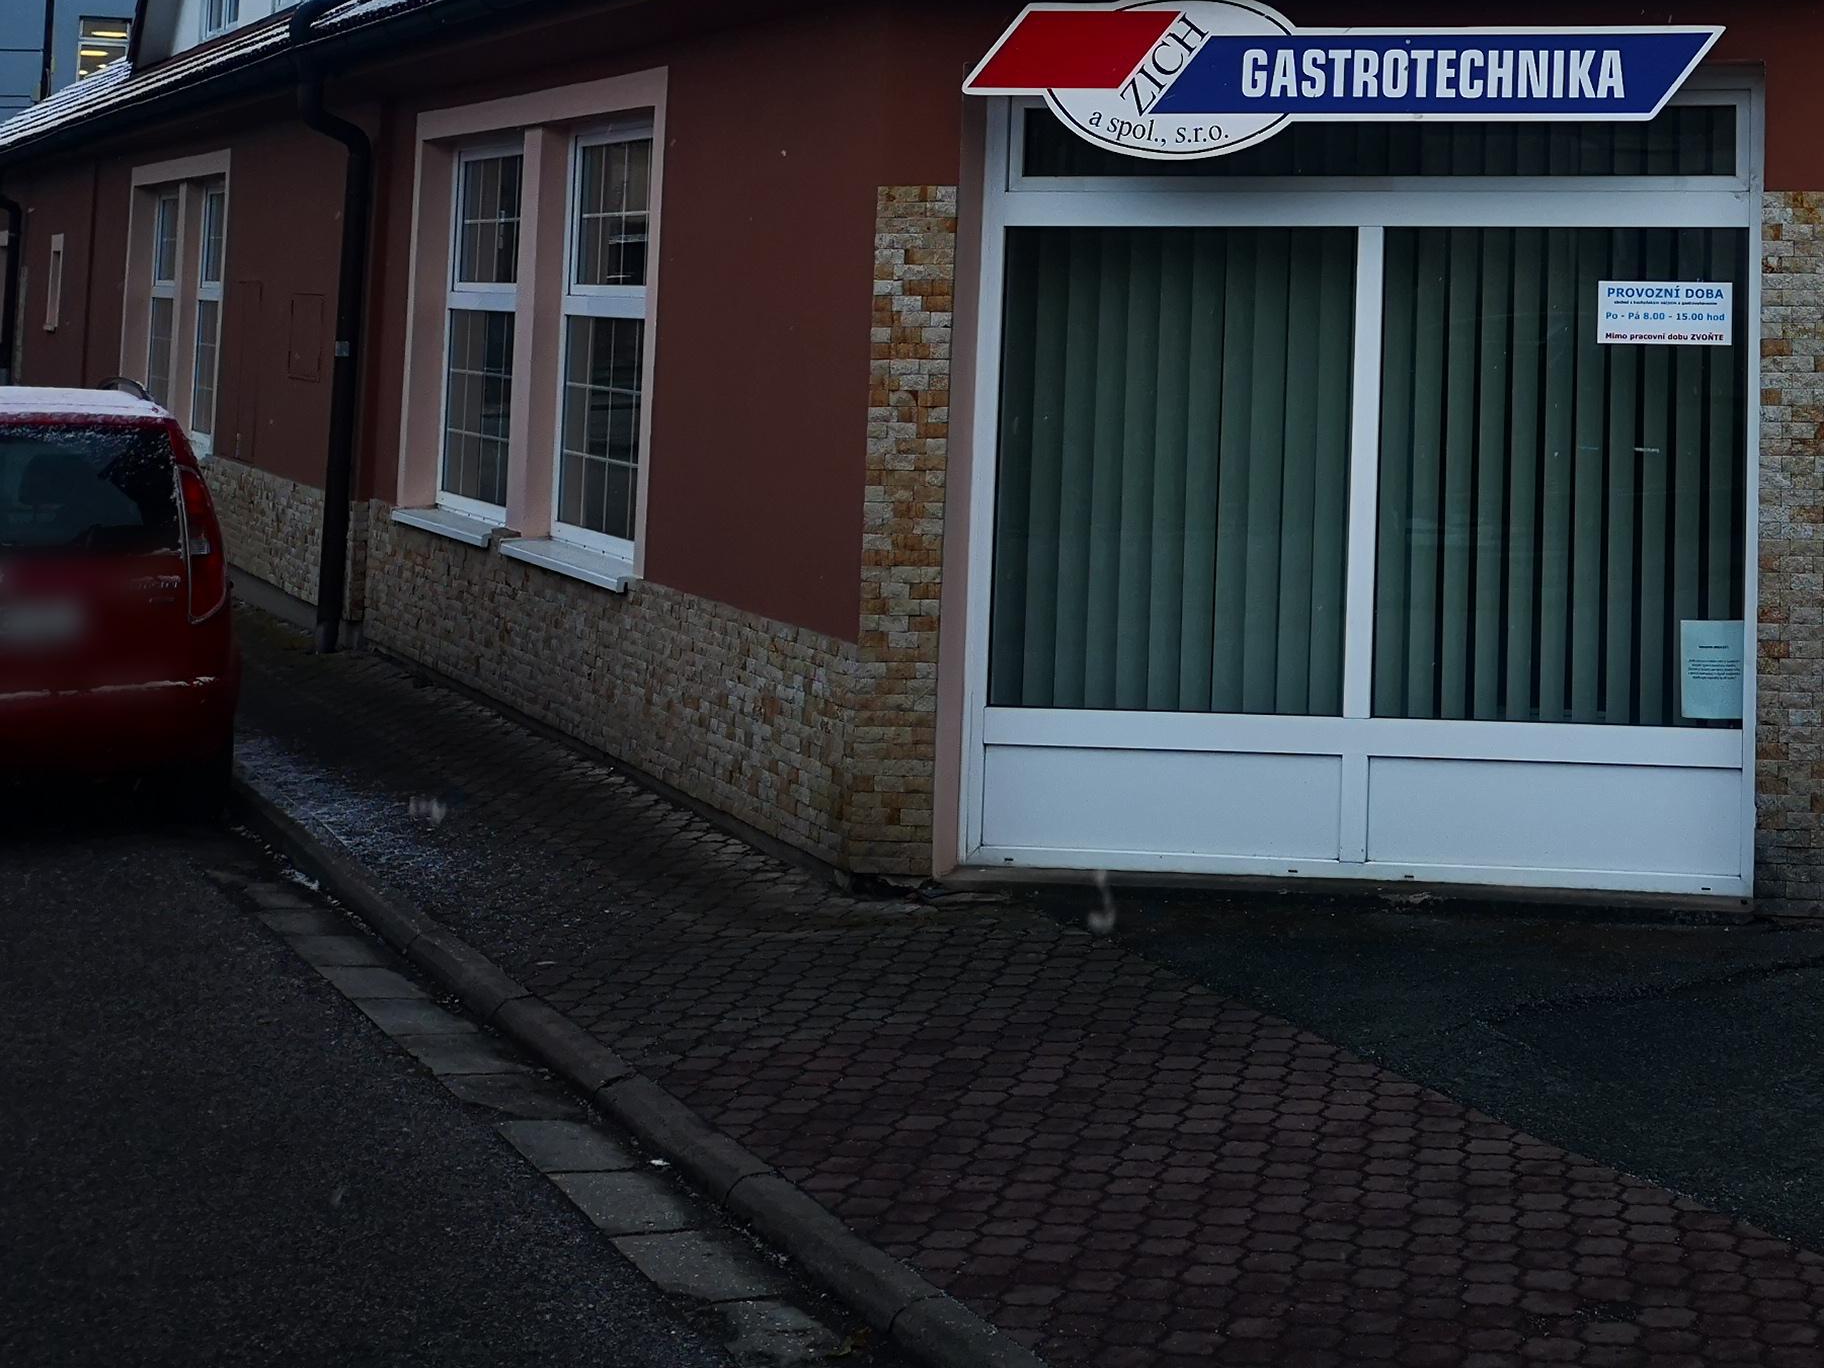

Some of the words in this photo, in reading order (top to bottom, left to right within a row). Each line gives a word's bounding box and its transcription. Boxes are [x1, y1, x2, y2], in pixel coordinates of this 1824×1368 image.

[1119, 11, 1210, 118] ZICH
[1240, 48, 1626, 99] GASTROTECHNIKA
[1088, 110, 1103, 128] a
[1106, 119, 1167, 148] spol.,
[1175, 124, 1230, 144] s.r.o.
[1607, 285, 1681, 299] PROVOZNÍ
[1685, 288, 1724, 299] DOBA
[1605, 311, 1618, 320] Po
[1628, 310, 1640, 320] Pá
[1643, 312, 1666, 320] 8.00
[1676, 313, 1704, 321] 15.00
[1706, 313, 1725, 321] hod
[1605, 332, 1628, 340] Mimo
[1629, 332, 1666, 341] pracovní
[1668, 333, 1689, 341] dobu
[1691, 331, 1724, 341] ZVOŇTE
